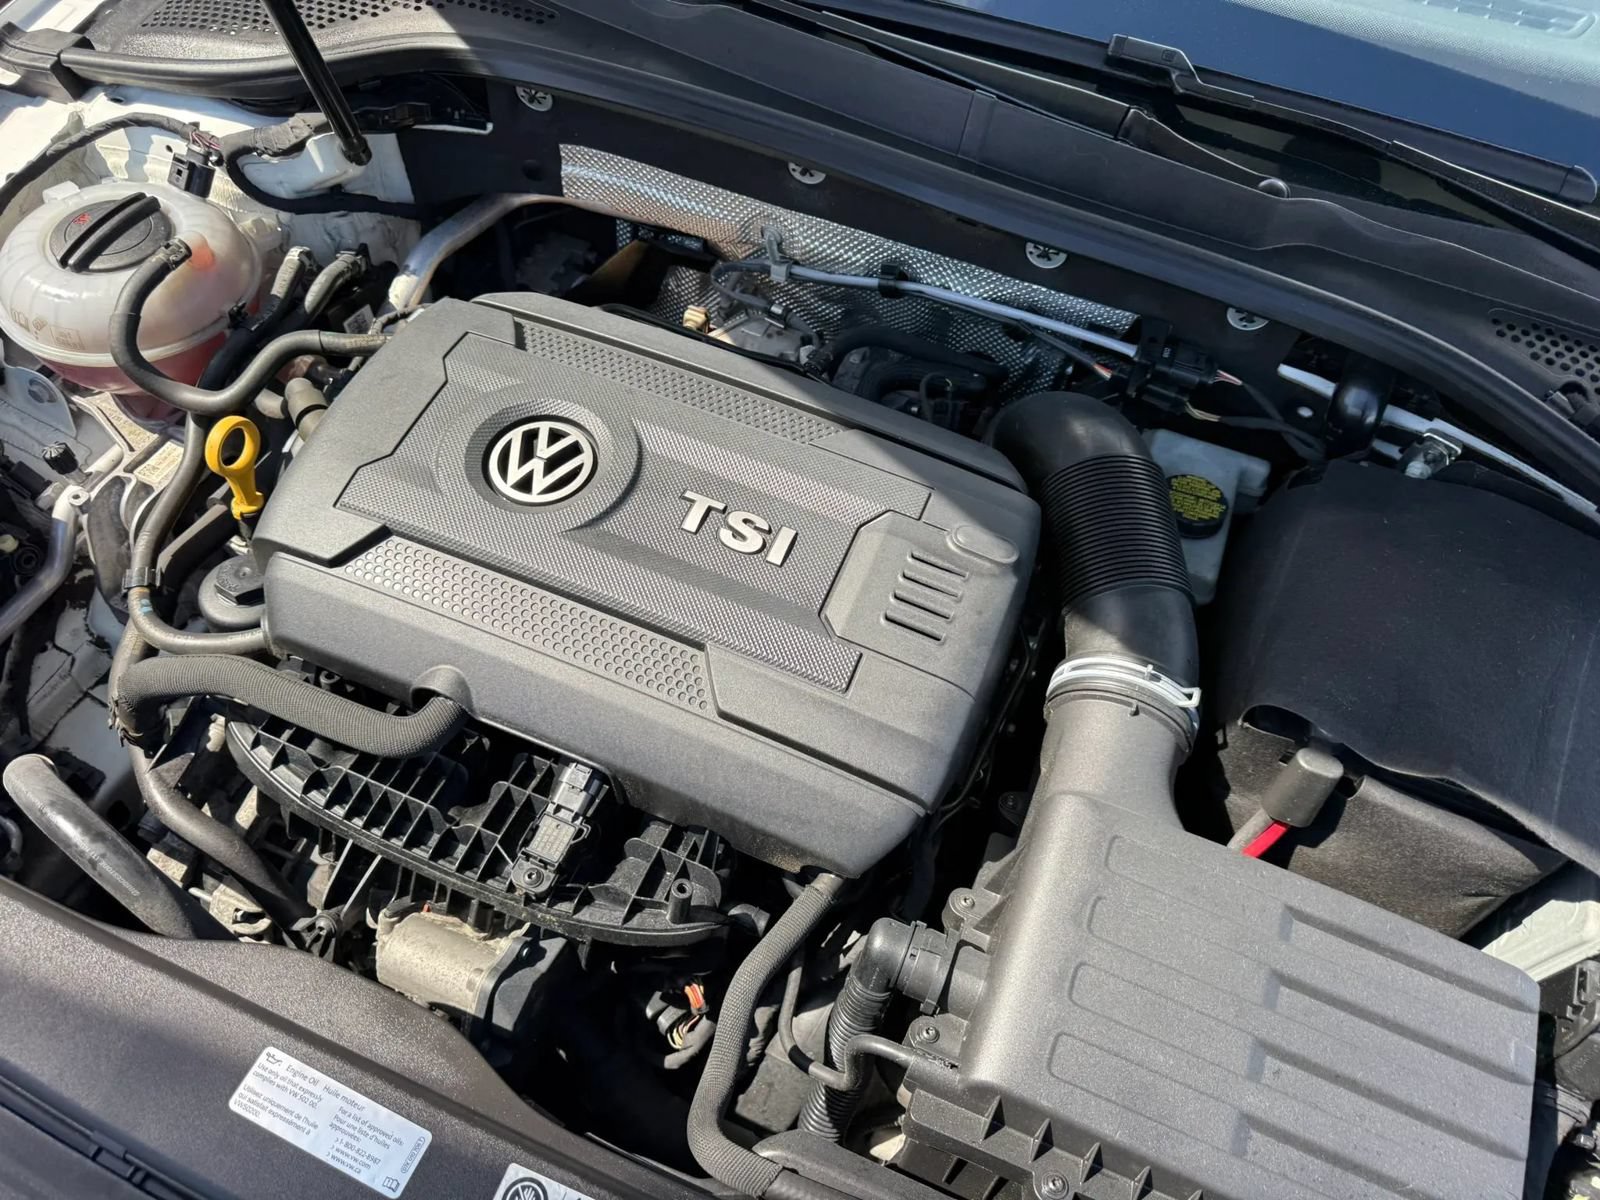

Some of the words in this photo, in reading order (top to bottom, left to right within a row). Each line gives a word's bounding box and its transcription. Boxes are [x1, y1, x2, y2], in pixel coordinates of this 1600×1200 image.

[680, 489, 798, 568] TSI
[238, 1092, 248, 1100] qui
[252, 1070, 276, 1086] complies
[275, 1083, 289, 1093] with
[288, 1088, 299, 1098] VW
[297, 1094, 309, 1104] 502
[267, 1068, 280, 1079] only
[279, 1074, 288, 1083] oil
[286, 1078, 299, 1089] that
[298, 1085, 323, 1103] expressly
[285, 1064, 309, 1082] Engine
[308, 1076, 320, 1087] Oil
[322, 1084, 341, 1099] Huile
[340, 1095, 365, 1112] moteur
[262, 1095, 295, 1117] uniquement
[293, 1113, 302, 1121] de
[338, 1105, 348, 1116] For
[351, 1113, 361, 1123] list
[360, 1119, 368, 1127] of
[366, 1123, 393, 1140] approved
[332, 1113, 347, 1125] Pour
[345, 1122, 358, 1131] une
[356, 1126, 370, 1138] liste
